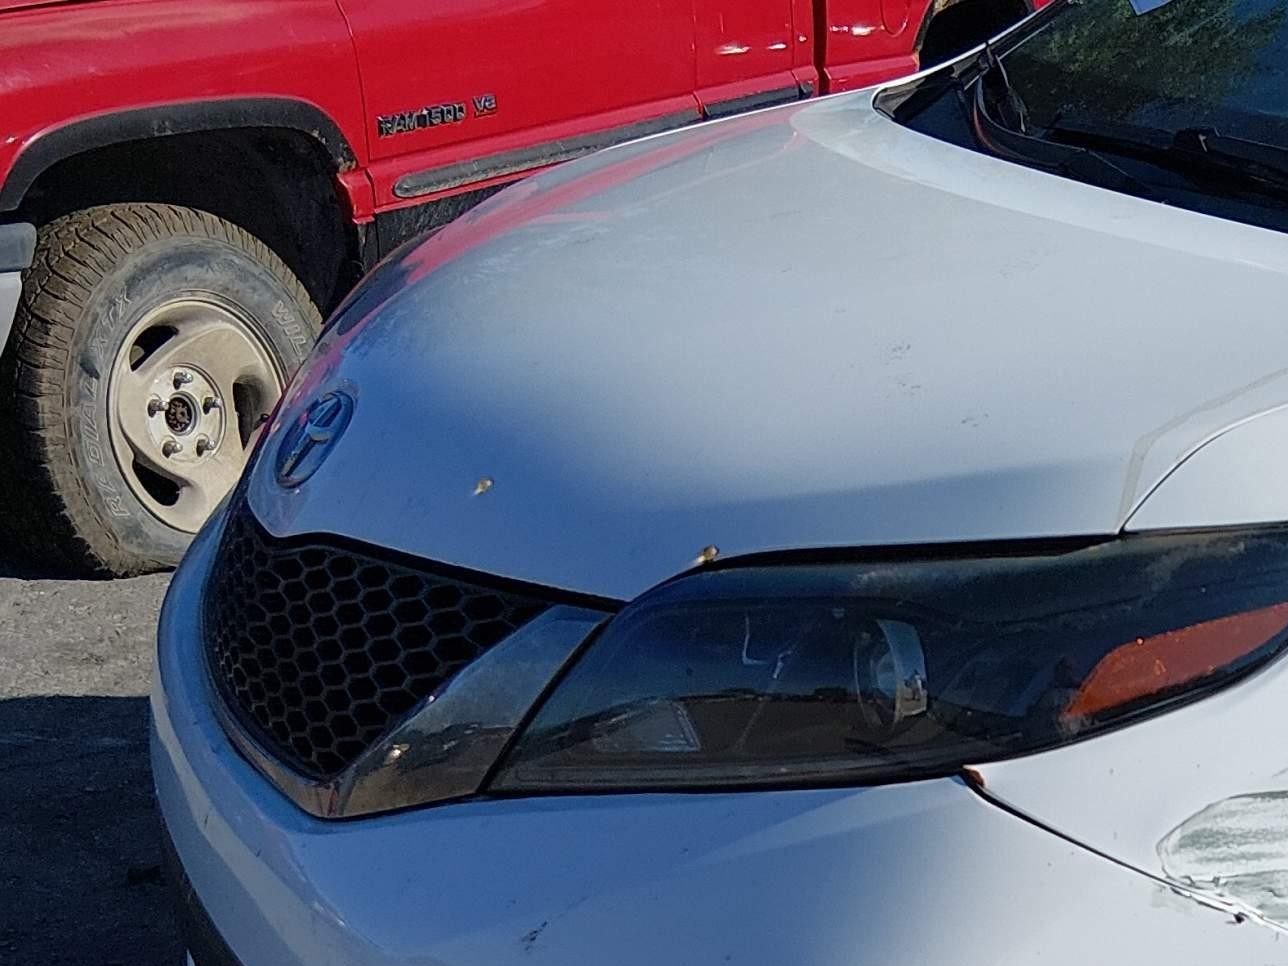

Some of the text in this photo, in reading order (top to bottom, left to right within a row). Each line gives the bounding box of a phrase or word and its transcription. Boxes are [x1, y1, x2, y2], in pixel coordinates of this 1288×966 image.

[377, 110, 418, 138] RAM
[420, 102, 467, 128] 1500
[272, 300, 309, 361] WIL
